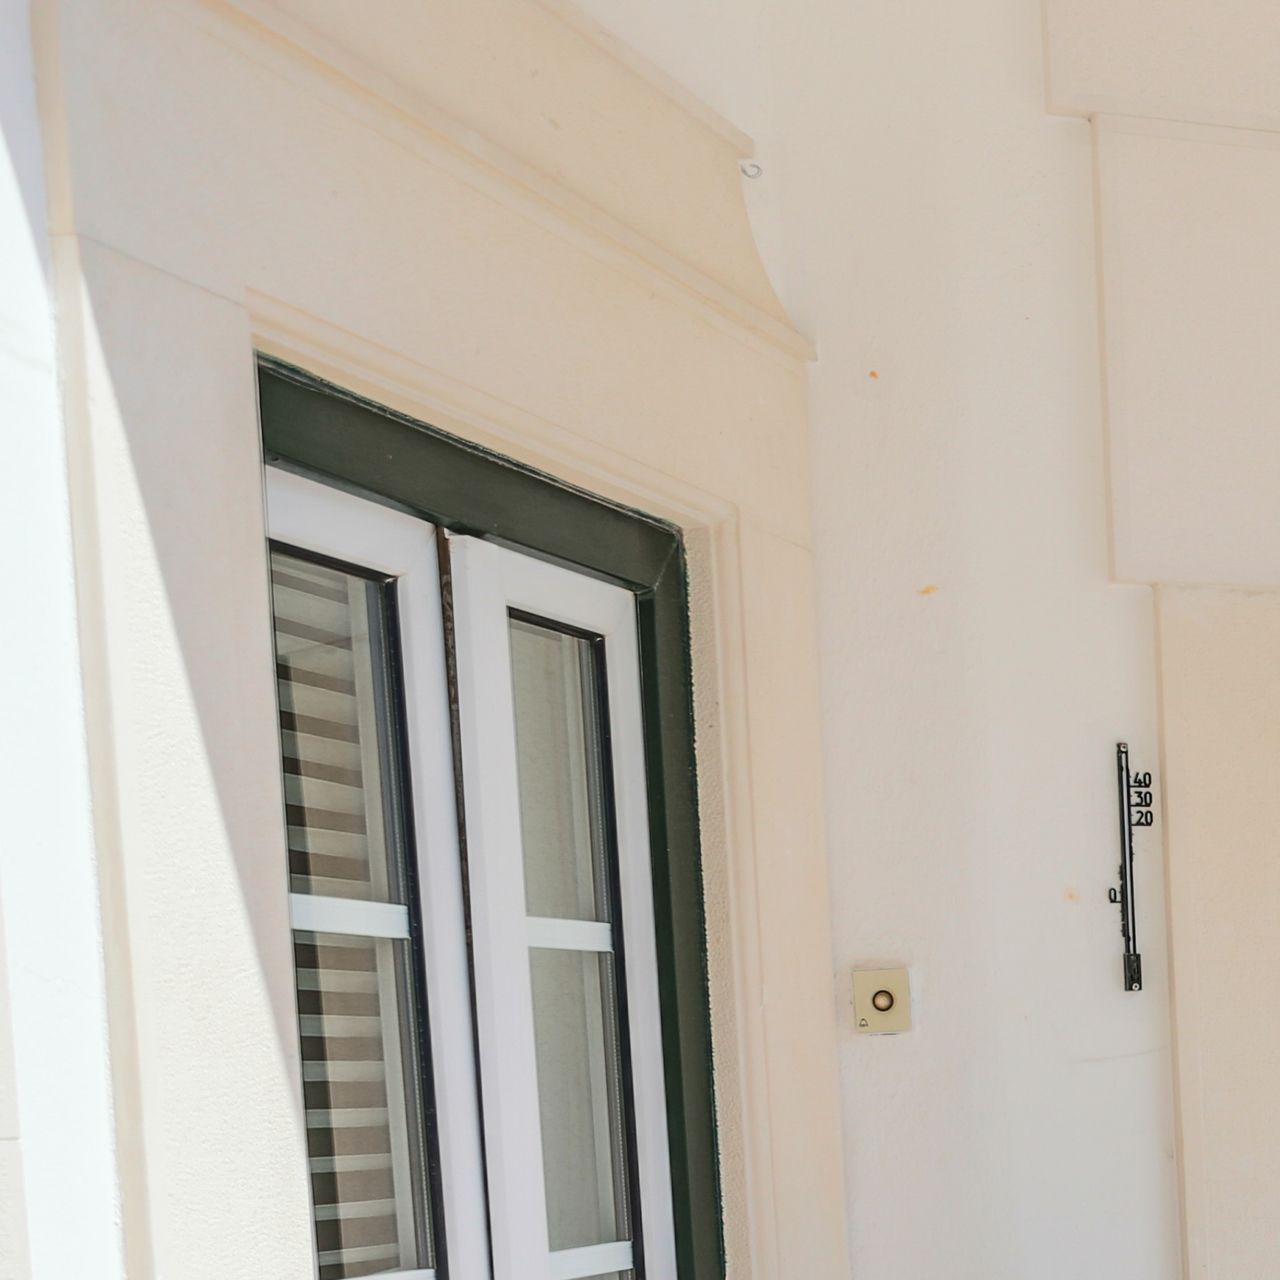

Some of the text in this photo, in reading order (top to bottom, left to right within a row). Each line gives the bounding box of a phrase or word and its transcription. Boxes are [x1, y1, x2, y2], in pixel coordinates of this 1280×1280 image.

[1133, 772, 1151, 786] 40
[1134, 791, 1153, 805] 30
[1135, 810, 1154, 825] 20
